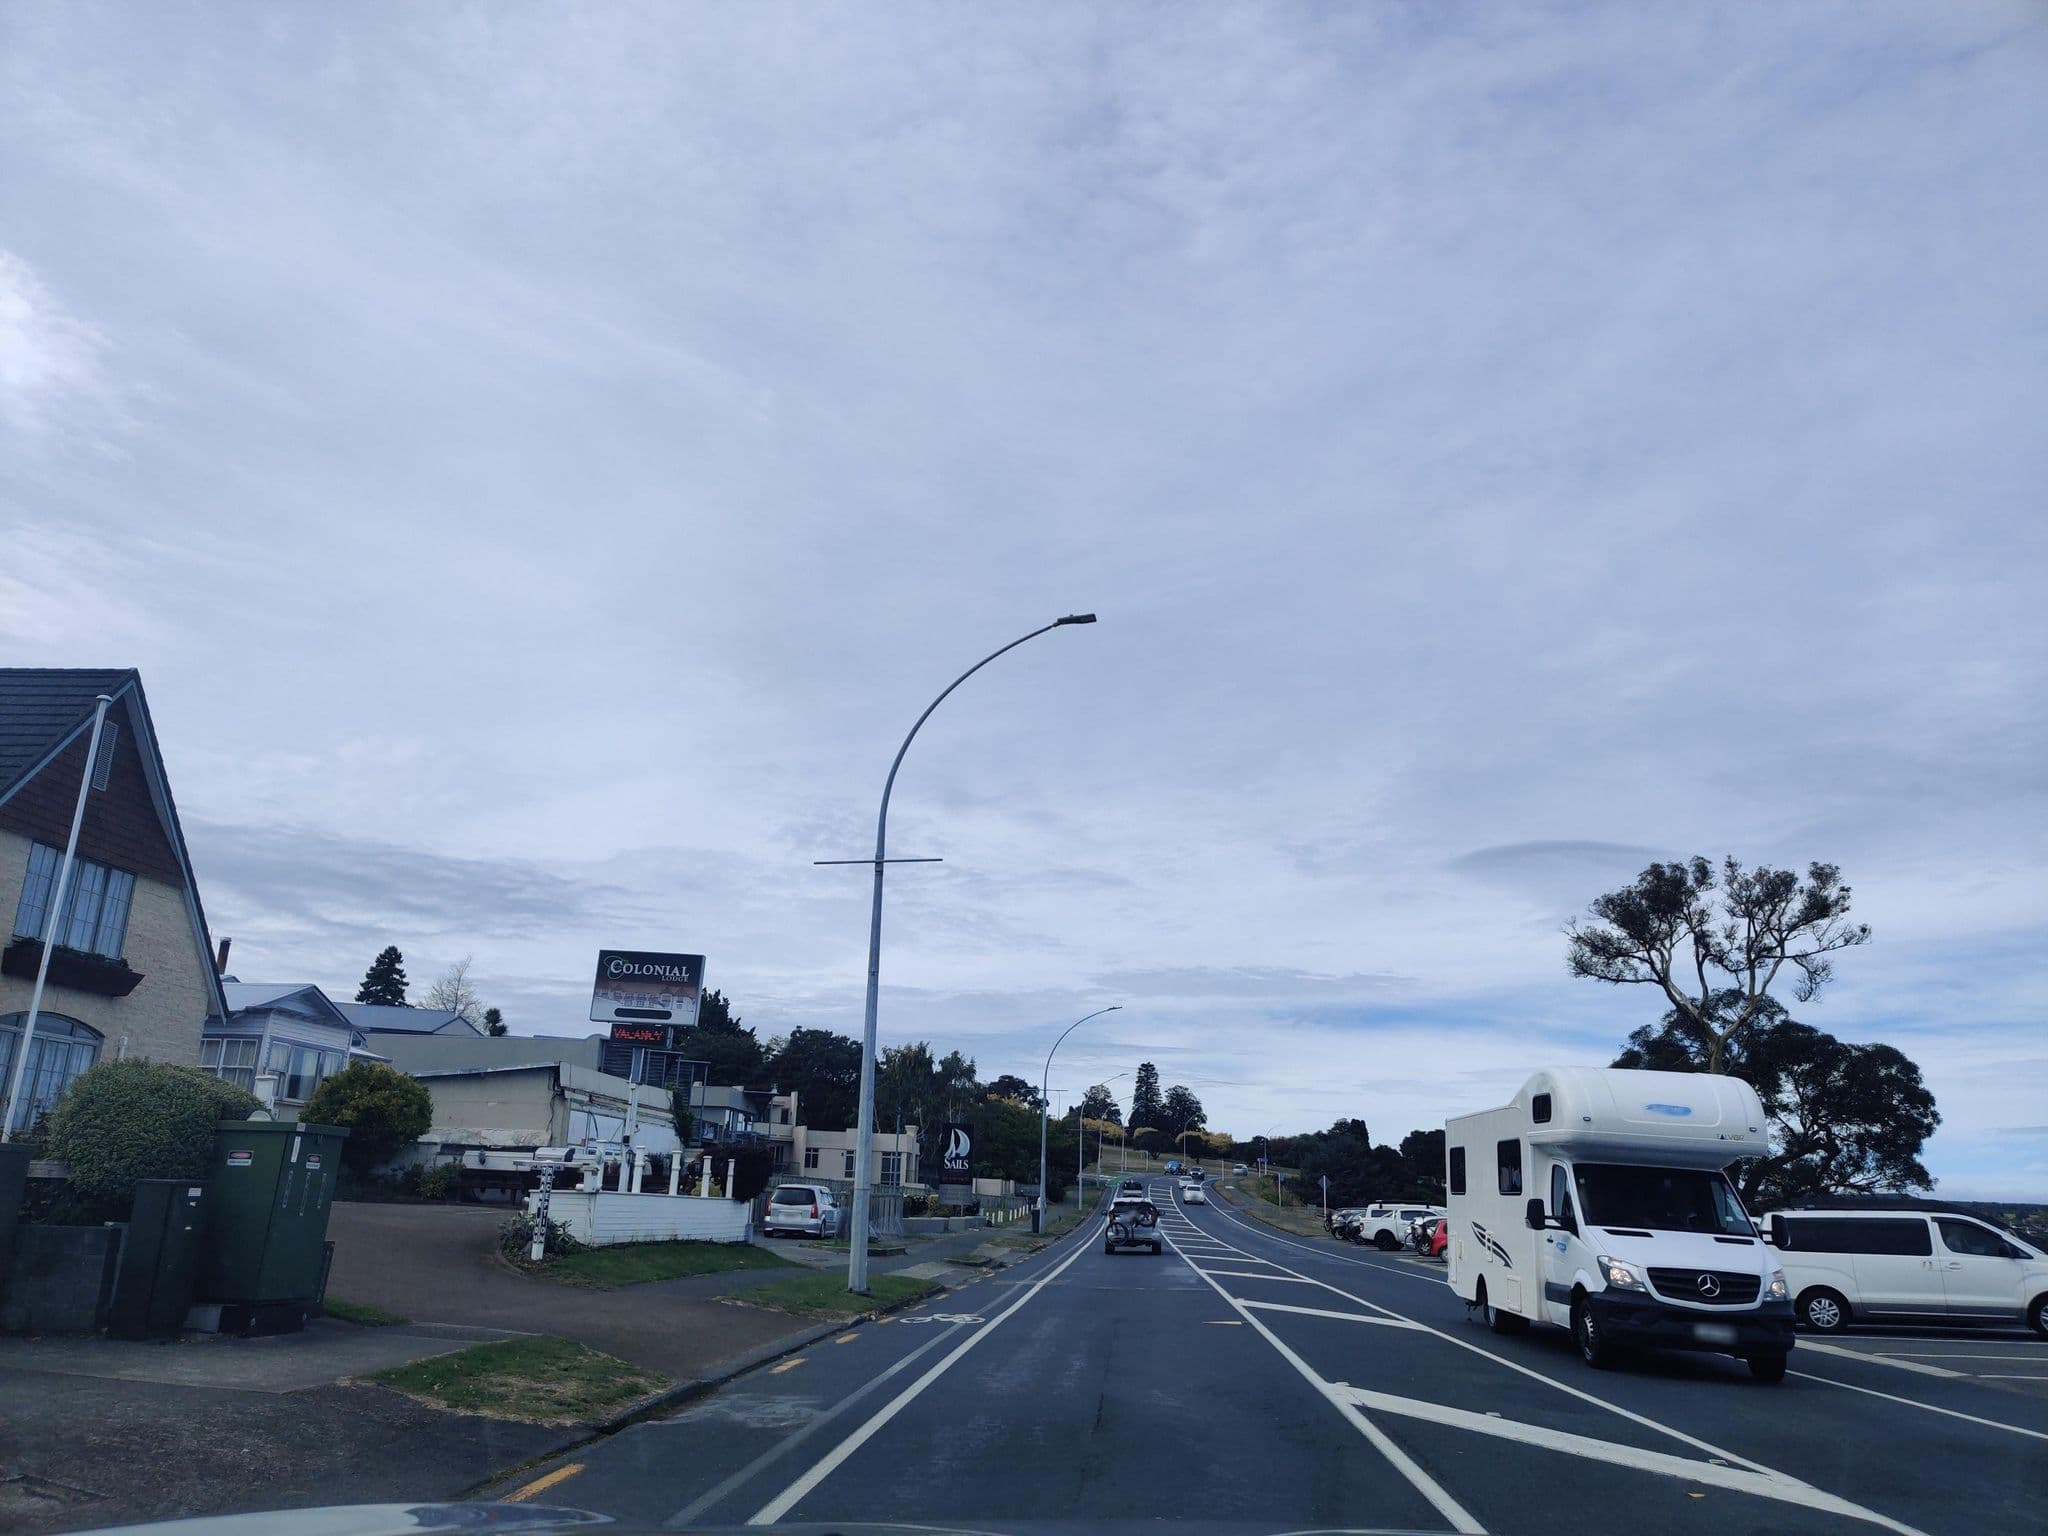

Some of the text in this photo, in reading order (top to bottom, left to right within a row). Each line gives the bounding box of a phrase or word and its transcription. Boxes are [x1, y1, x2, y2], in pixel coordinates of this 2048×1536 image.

[610, 959, 690, 977] COLONIAL
[661, 975, 689, 983] LODGE
[944, 1157, 969, 1170] SAILS
